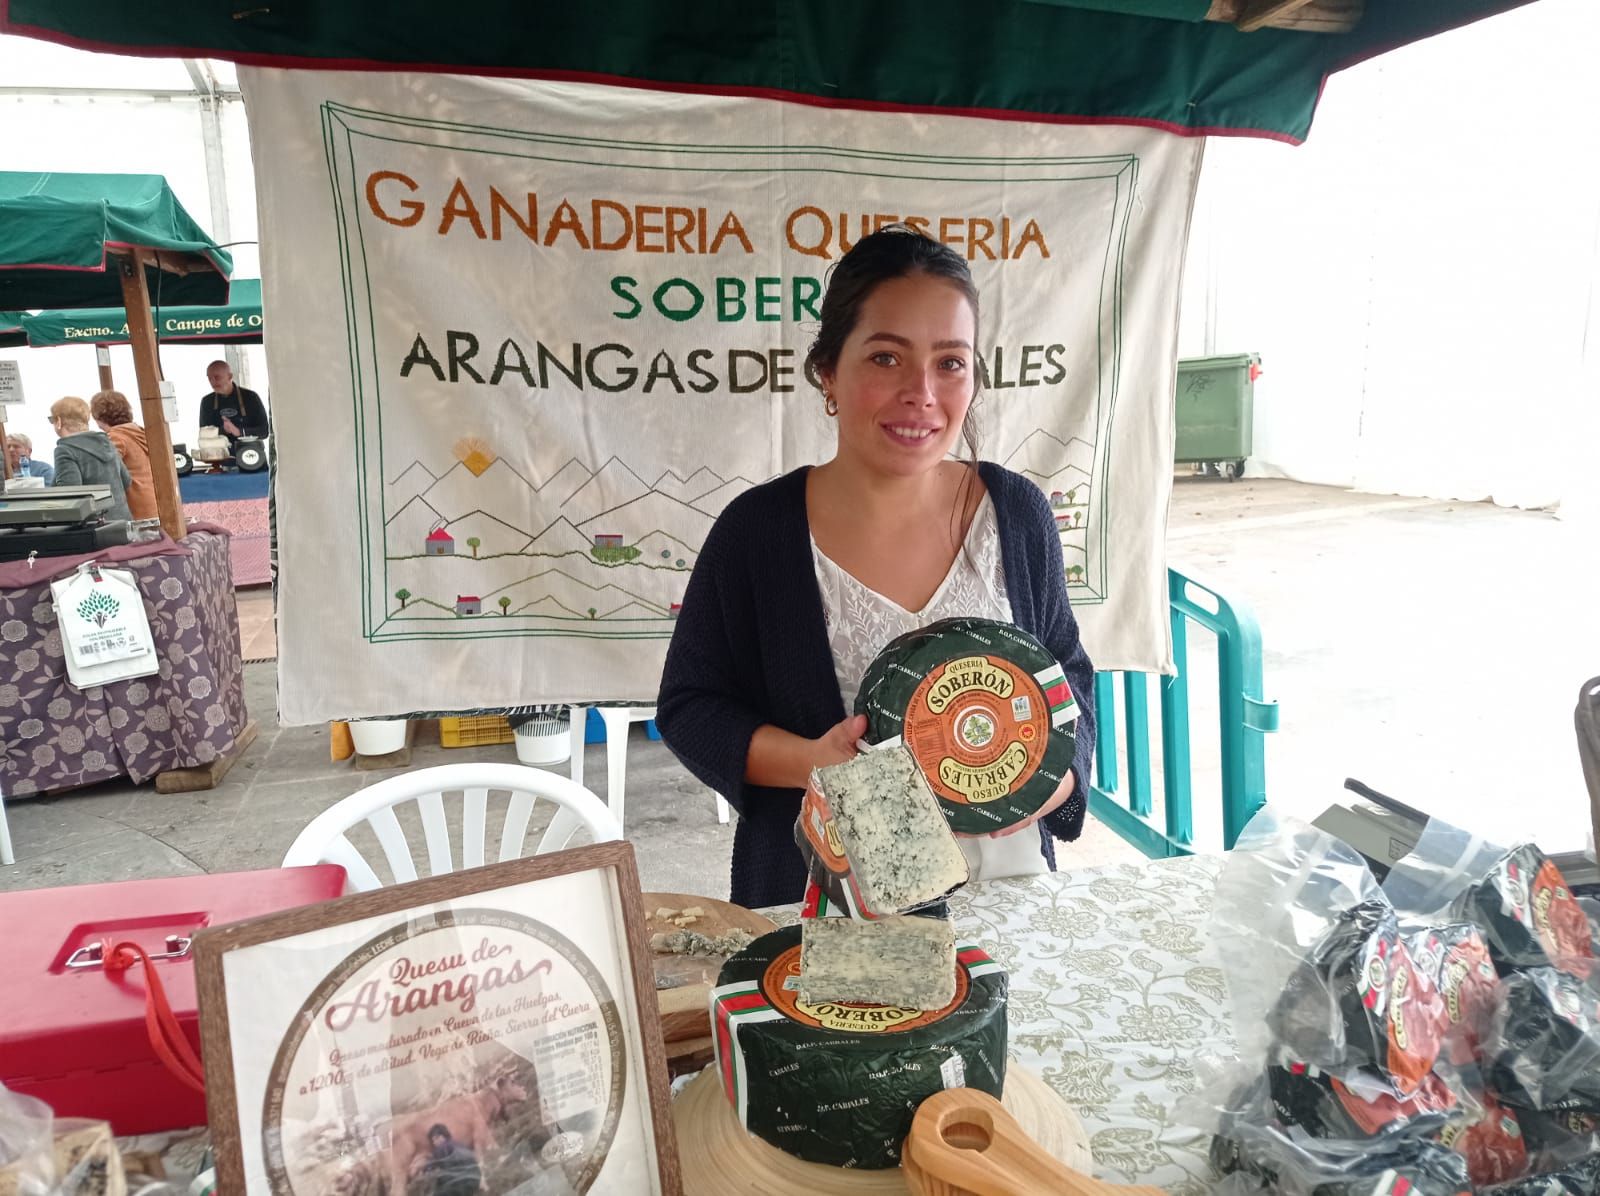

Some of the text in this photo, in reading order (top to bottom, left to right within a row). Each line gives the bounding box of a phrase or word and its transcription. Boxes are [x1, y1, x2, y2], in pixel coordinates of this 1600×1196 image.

[365, 170, 754, 255] GANADERIA
[610, 275, 821, 323] SOBER
[64, 326, 114, 339] Excmo.
[166, 316, 221, 335] Cangas
[227, 313, 245, 327] de
[399, 330, 720, 394] ARANGAS
[728, 348, 795, 394] DE
[949, 660, 983, 674] QUESERIA
[930, 669, 1011, 708] SOBERÓN
[941, 748, 1027, 788] CABRALES
[972, 782, 1006, 800] QUESO
[388, 954, 467, 988] Quesu
[471, 936, 513, 963] de
[324, 958, 553, 1032] Arangas
[418, 1042, 449, 1061] Vega
[450, 1034, 464, 1050] de
[505, 1016, 539, 1035] Sierra
[541, 1007, 558, 1026] del
[557, 1000, 591, 1020] Cuera
[443, 1016, 481, 1034] Cueva
[494, 1002, 512, 1018] las
[829, 1019, 879, 1030] QUESERIA
